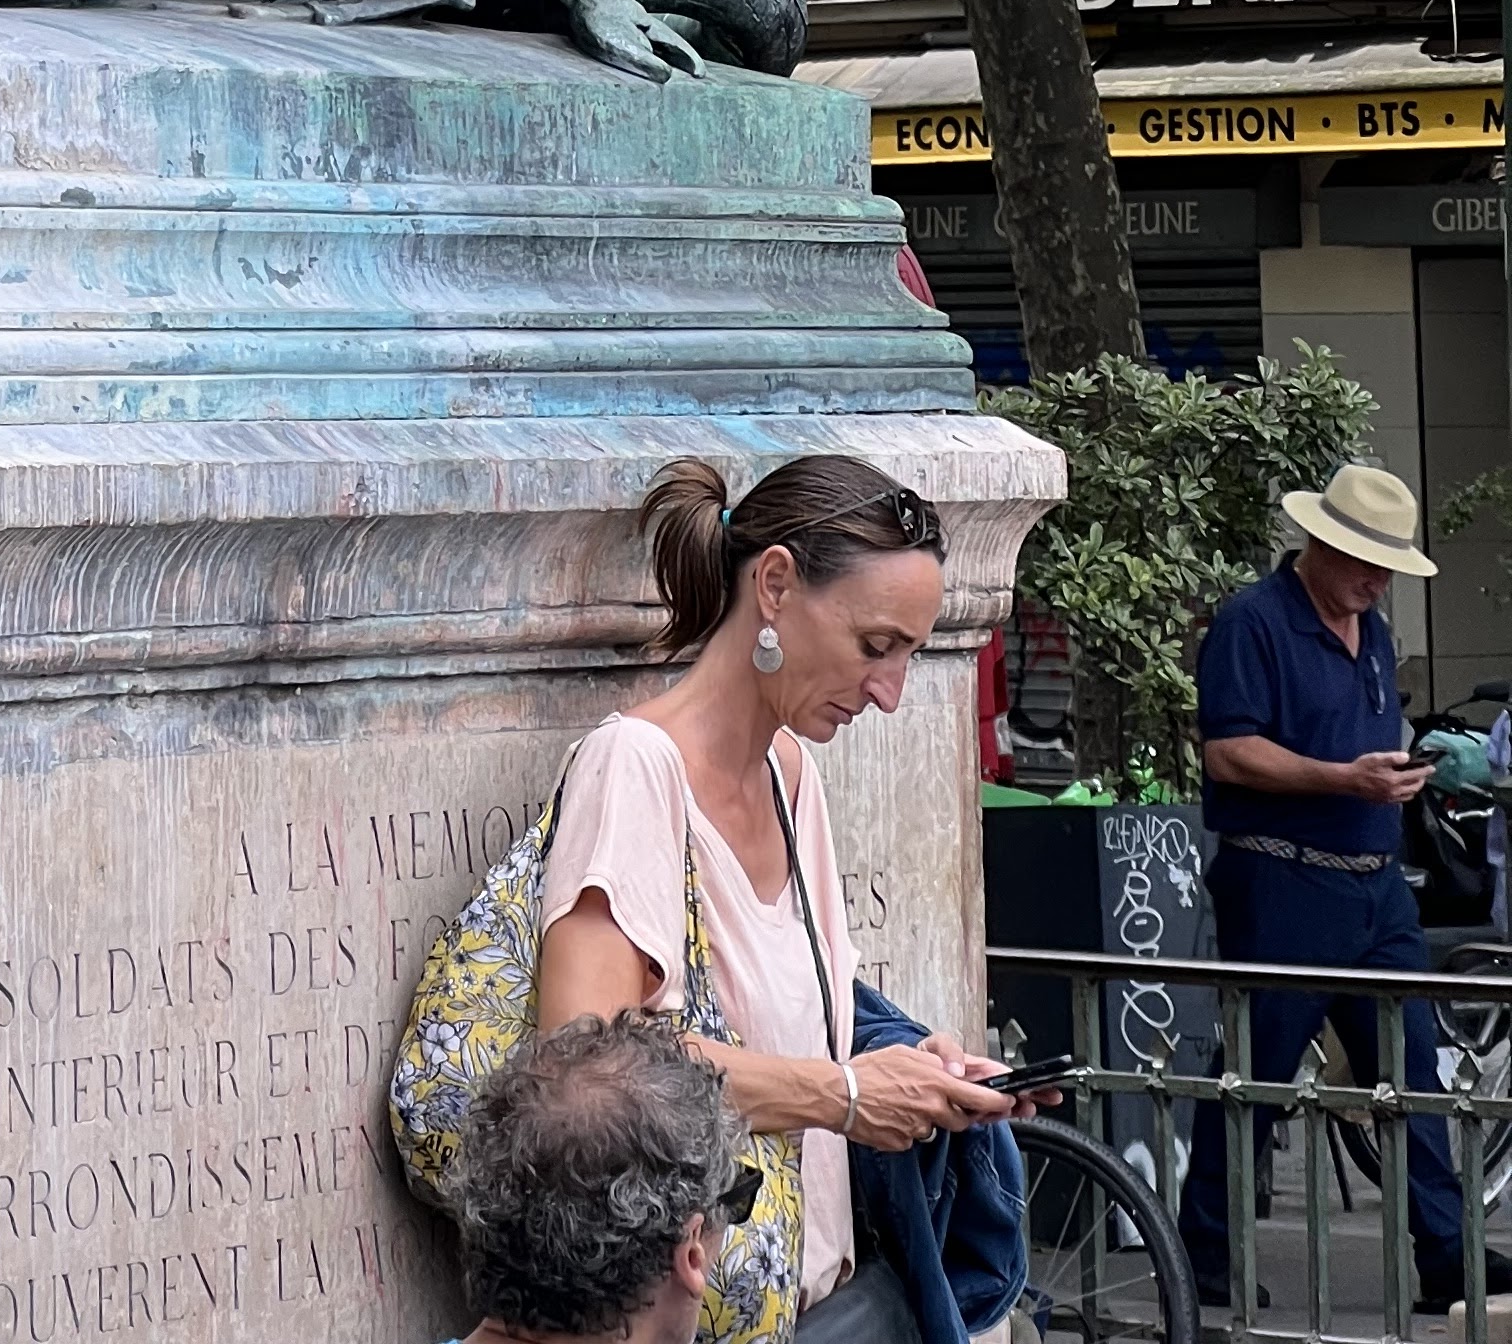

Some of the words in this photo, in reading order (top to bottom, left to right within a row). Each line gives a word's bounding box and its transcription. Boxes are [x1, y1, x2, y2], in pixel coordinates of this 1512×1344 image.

[896, 116, 990, 152] ECON
[1139, 106, 1295, 144] GESTION
[1357, 101, 1421, 138] BTS
[905, 206, 969, 239] UNE
[1124, 201, 1200, 236] EUNE
[230, 830, 259, 898] A
[286, 822, 340, 893] LA
[366, 801, 548, 886] MEMO
[268, 925, 357, 996] DES
[267, 1029, 319, 1098] ET
[275, 1237, 326, 1303] LA
